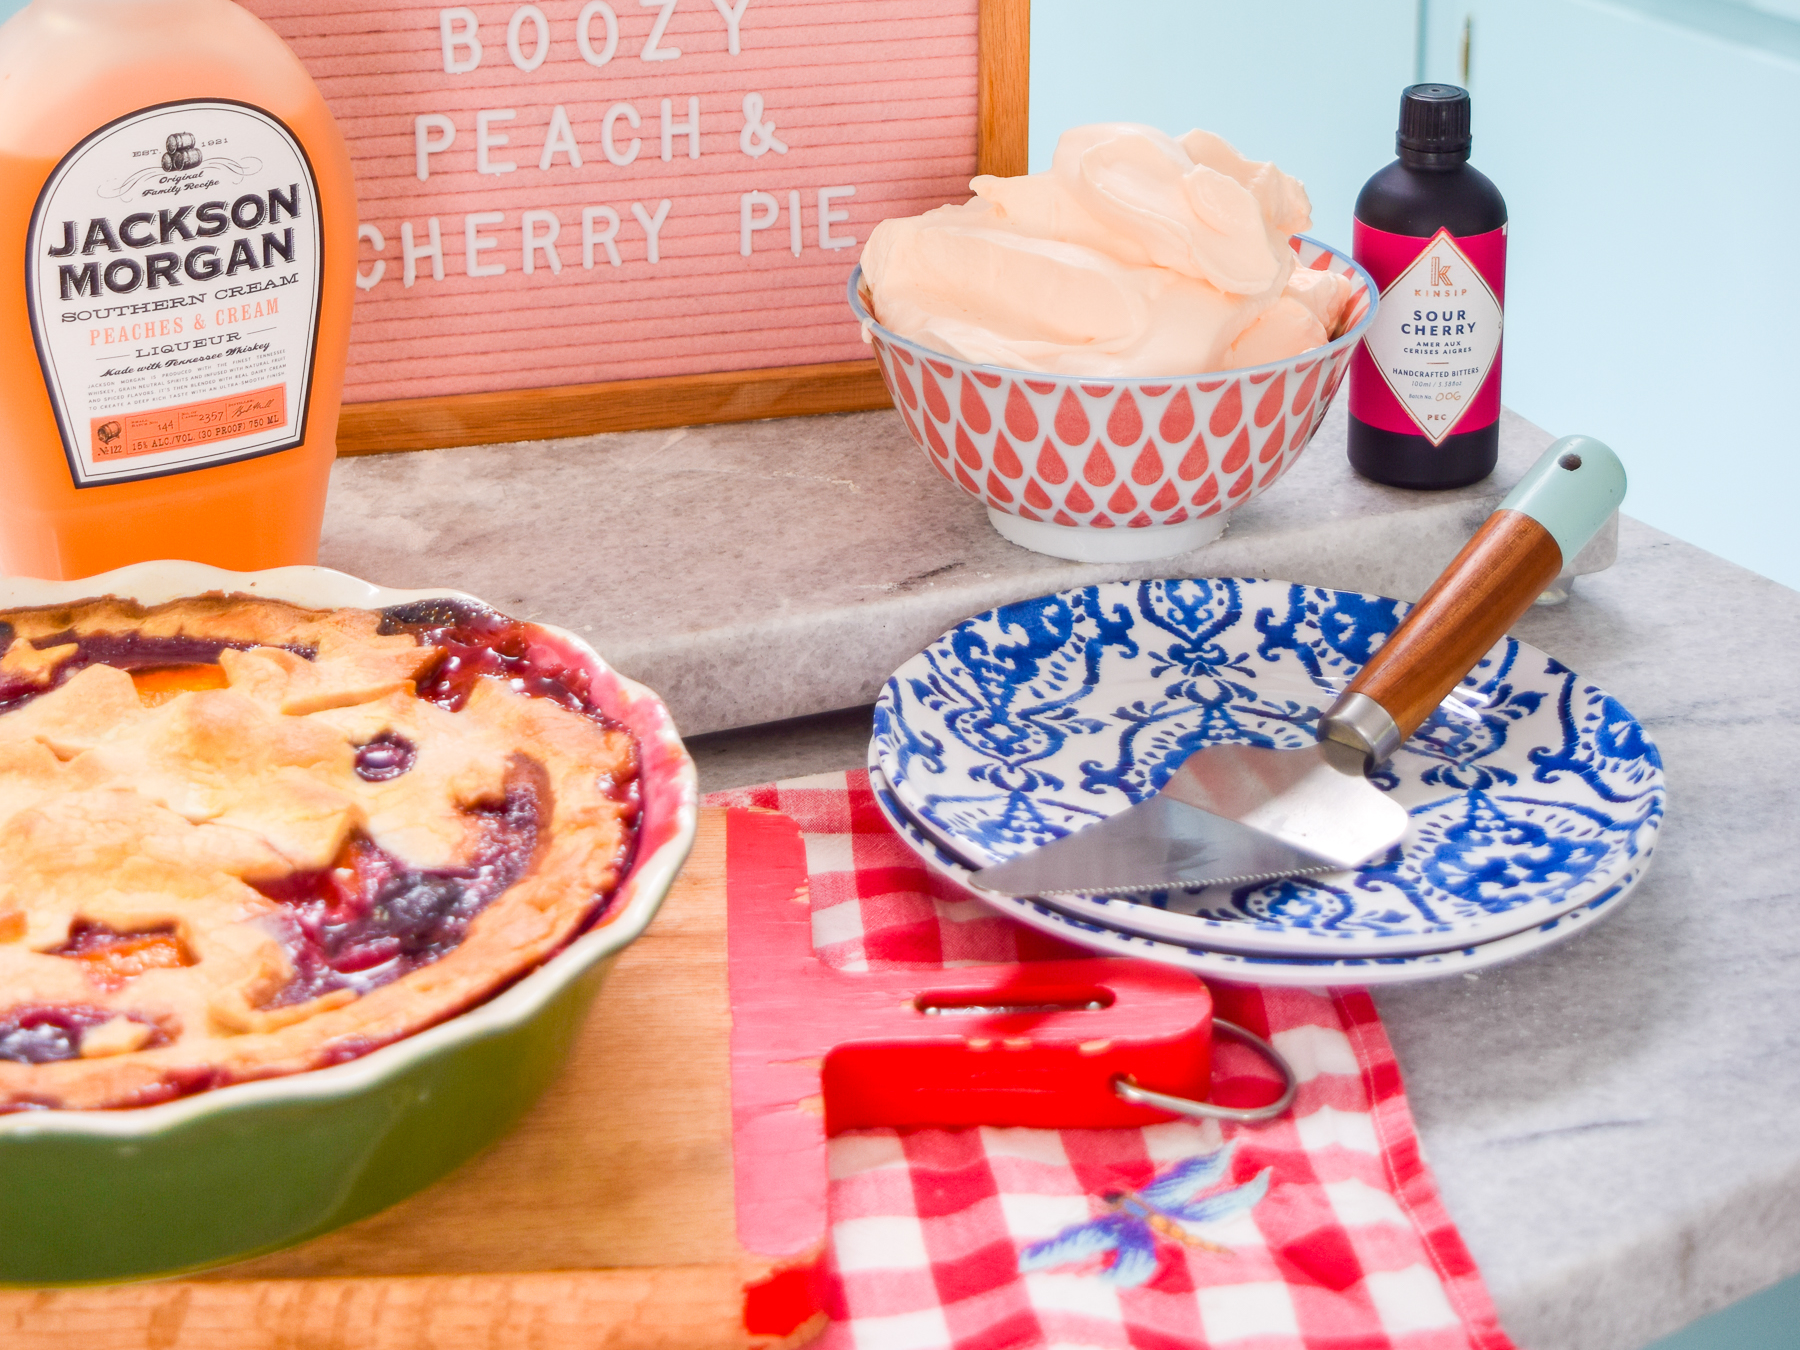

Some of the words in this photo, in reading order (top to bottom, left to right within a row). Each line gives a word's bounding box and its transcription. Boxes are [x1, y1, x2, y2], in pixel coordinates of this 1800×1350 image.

[414, 96, 701, 181] PEACH
[739, 91, 789, 158] &
[132, 148, 162, 158] EST.
[159, 170, 204, 184] Original
[142, 184, 182, 197] Family
[183, 179, 220, 192] Recipe
[47, 183, 301, 258] JACKSON
[356, 200, 672, 291] CHERRY
[739, 185, 857, 258] PIE
[58, 227, 296, 301] MORGAN
[61, 292, 208, 323] SOUTHERN
[214, 272, 299, 300] CREAM
[1414, 288, 1468, 298] KINSIP
[89, 316, 184, 347] PEACHES
[193, 313, 207, 330] &
[215, 297, 280, 326] CREAM
[1413, 309, 1466, 322] SOUR
[1400, 321, 1476, 336] CHERRY
[135, 331, 242, 358] LIQUEUR
[1403, 347, 1439, 355] CERISES
[1443, 346, 1472, 355] AIGRES
[99, 365, 134, 377] Made
[137, 361, 163, 372] with
[164, 353, 223, 368] Tennessee
[225, 342, 270, 356] Whiskey
[88, 381, 115, 389] JACKSON
[162, 369, 192, 377] PRODUCED
[233, 357, 251, 365] FINEST
[256, 349, 286, 359] TENNESSEE
[138, 381, 165, 389] NEUTRAL
[204, 369, 228, 378] INFUSED
[245, 360, 270, 369] NATURAL
[190, 379, 216, 388] BLENDED
[268, 363, 287, 371] CREAM
[1392, 367, 1449, 378] HANDCRAFTED
[1451, 366, 1479, 377] BITTERS
[1411, 380, 1431, 388] 100ml
[100, 402, 124, 410] CREATE
[169, 391, 188, 399] TASTE
[1435, 391, 1462, 402] 006
[158, 420, 174, 432] 144
[199, 411, 224, 424] 2357
[1427, 413, 1447, 421] PEC
[133, 440, 148, 451] 15%
[198, 429, 212, 440] (30
[215, 422, 246, 436] PROOF)
[249, 418, 264, 428] 750
[267, 415, 280, 424] ML
